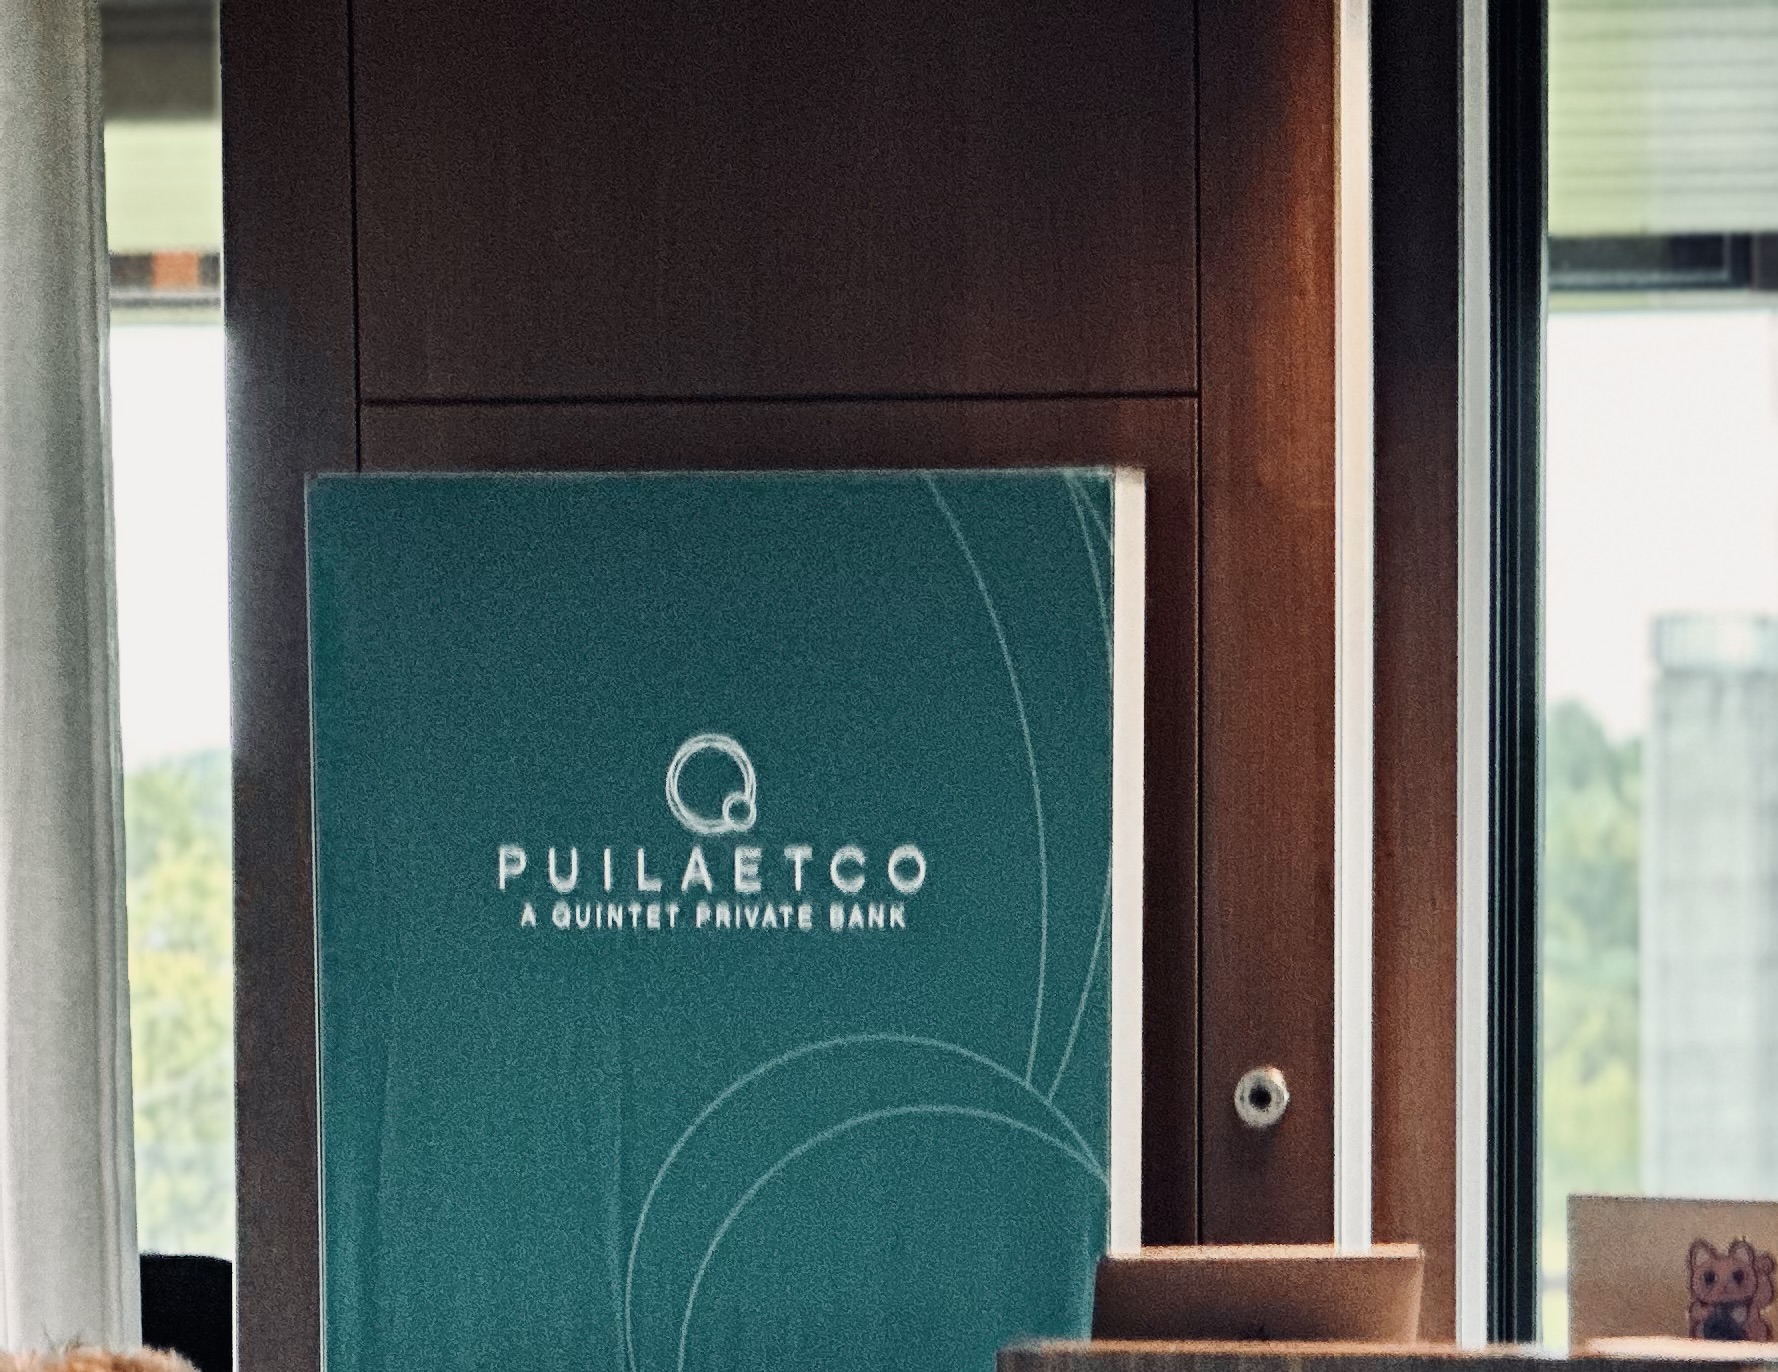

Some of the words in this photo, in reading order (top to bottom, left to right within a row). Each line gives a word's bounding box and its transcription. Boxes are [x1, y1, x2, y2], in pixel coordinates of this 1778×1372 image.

[498, 844, 927, 894] PUILAETCO
[520, 903, 537, 929] A
[552, 903, 679, 929] QUINTET
[695, 903, 813, 929] PRIVATE
[829, 904, 907, 930] BANK
